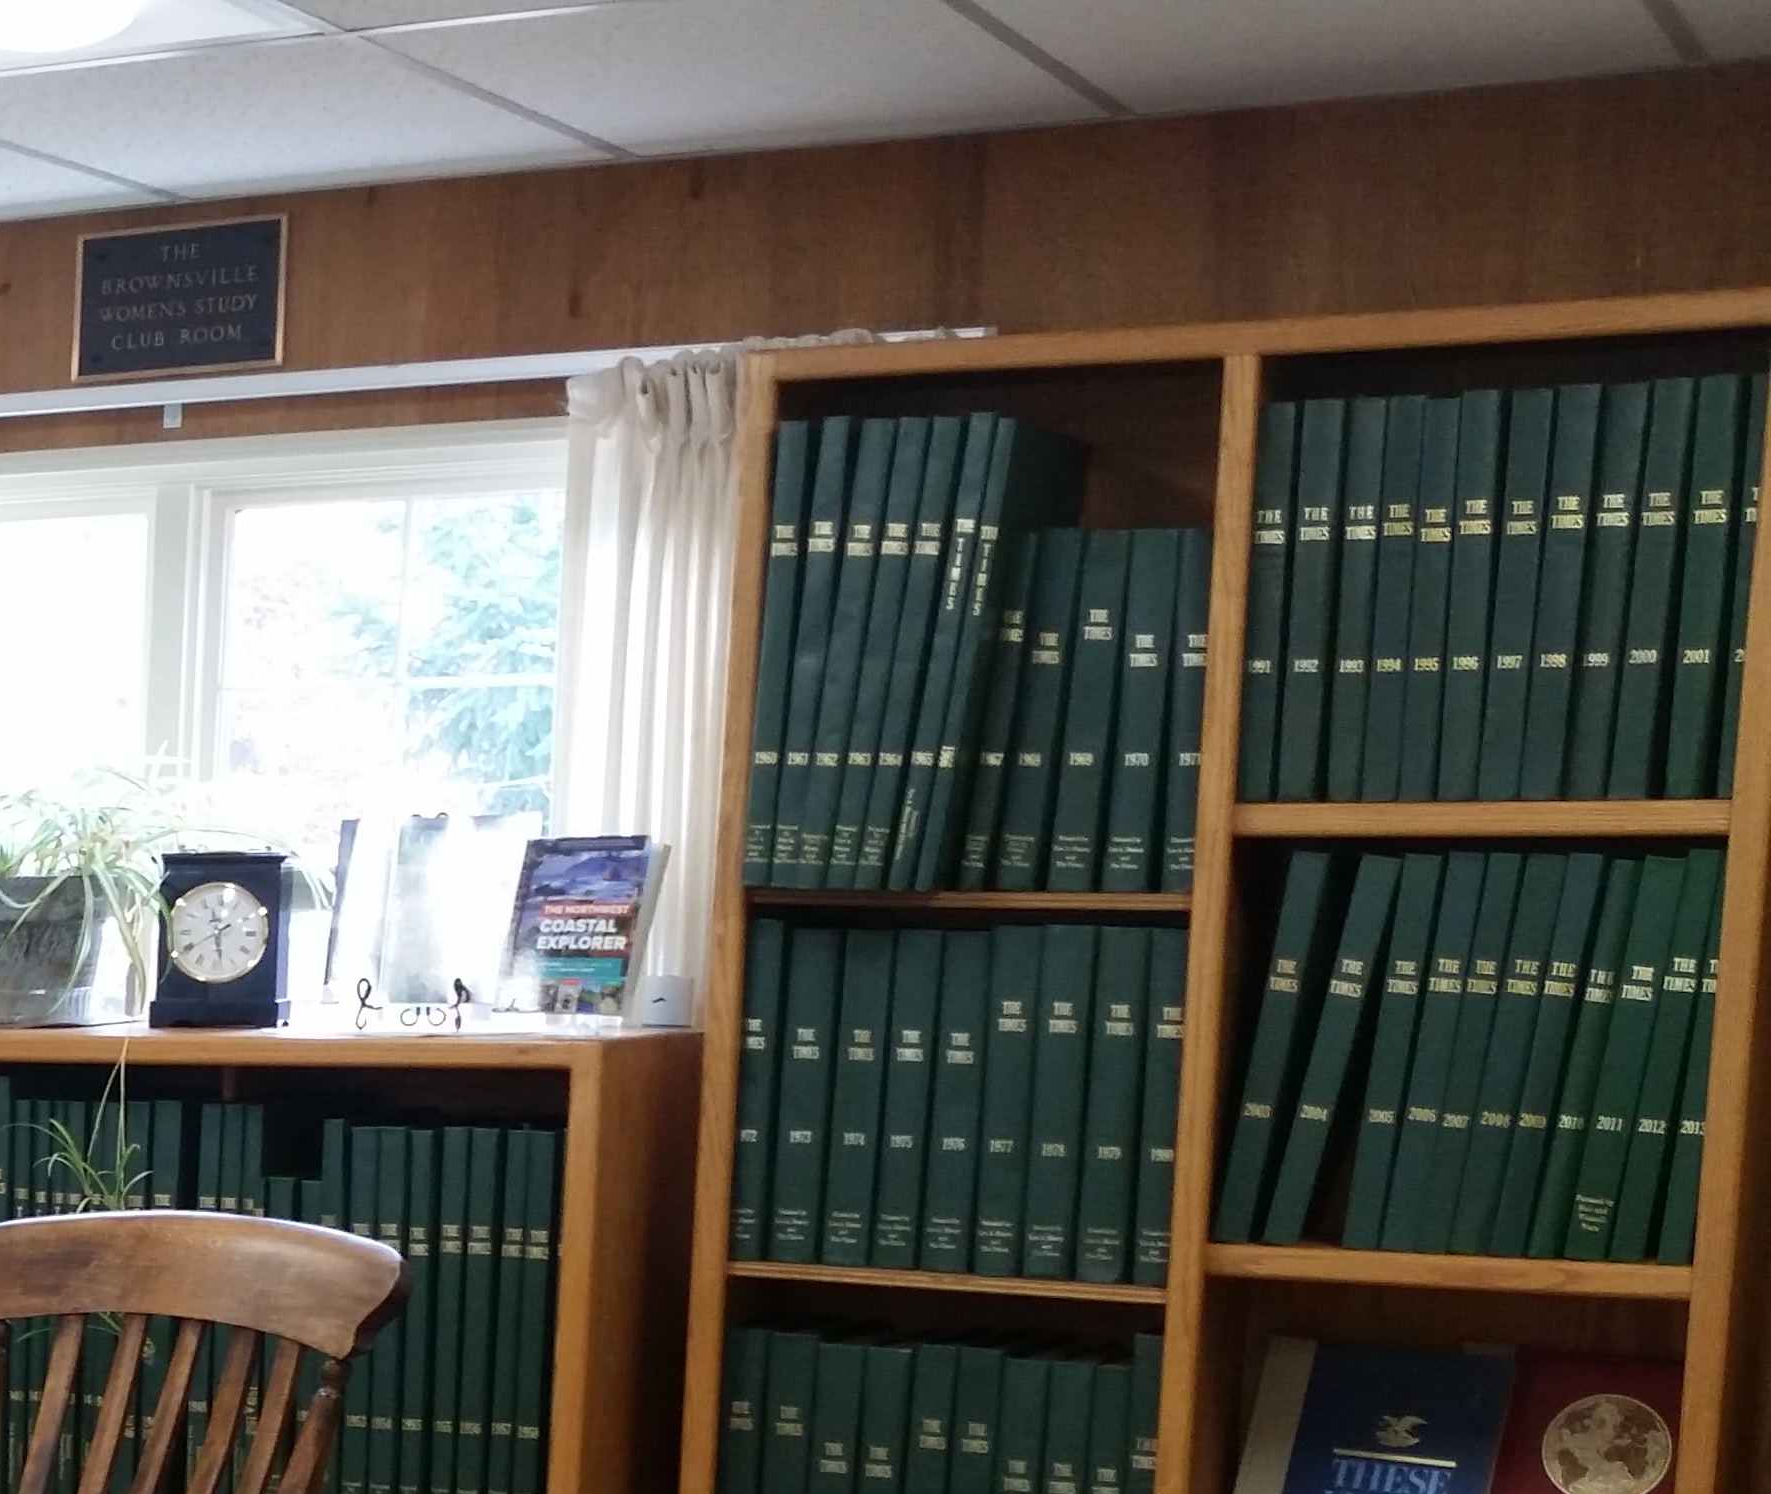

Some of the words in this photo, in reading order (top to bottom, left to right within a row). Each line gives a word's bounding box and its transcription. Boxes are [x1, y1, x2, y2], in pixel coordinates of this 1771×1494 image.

[161, 243, 200, 261] THE
[101, 265, 257, 295] BROWNSVILLE
[100, 300, 186, 322] WOMENS
[195, 294, 258, 315] STUDY
[111, 331, 165, 350] CLUB
[180, 324, 242, 344] ROOM
[540, 919, 617, 933] COASTAL
[536, 936, 626, 949] EXPLORER
